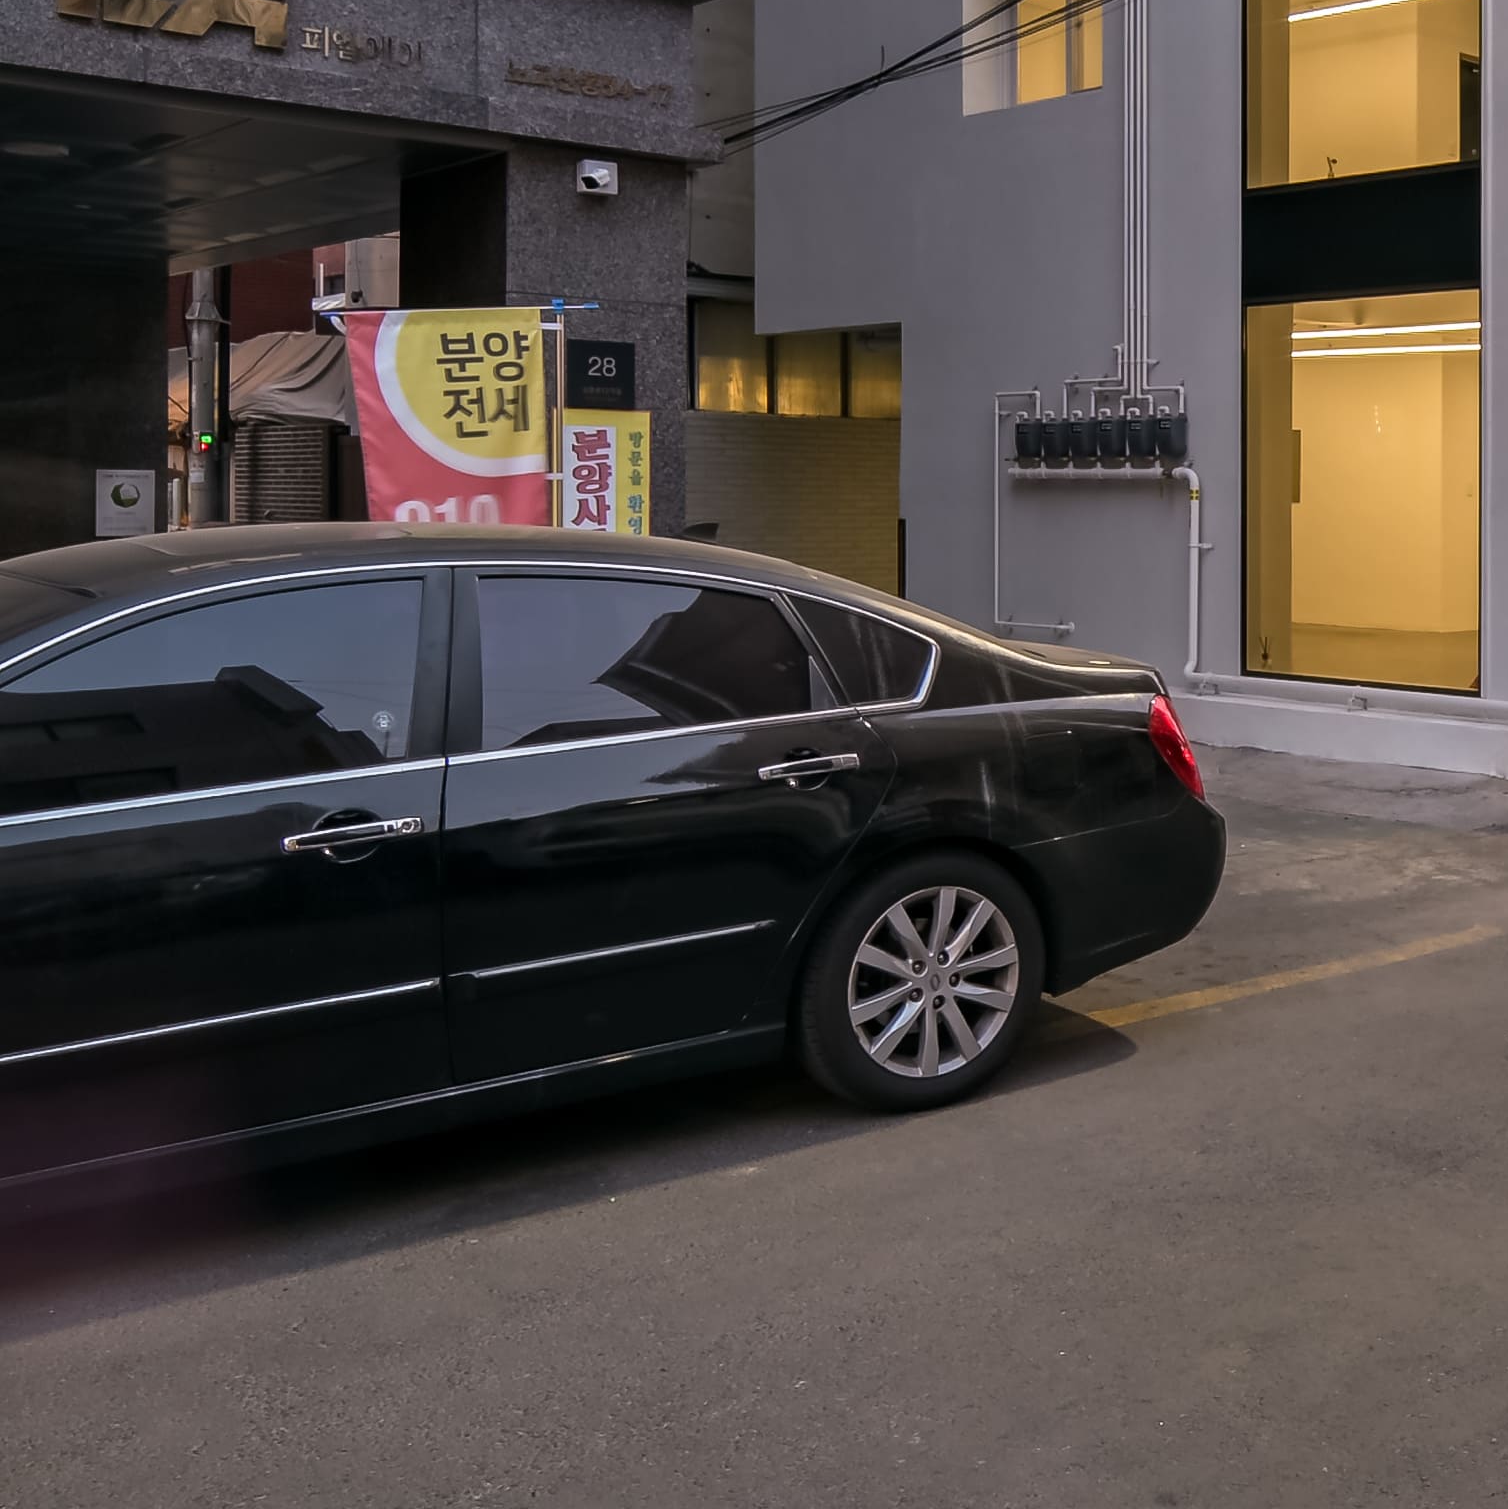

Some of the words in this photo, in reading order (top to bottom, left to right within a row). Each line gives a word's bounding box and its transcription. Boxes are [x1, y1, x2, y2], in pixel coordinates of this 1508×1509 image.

[436, 330, 530, 383] 분양
[587, 356, 617, 378] 28
[443, 385, 530, 439] 전세
[572, 429, 612, 531] 분양사
